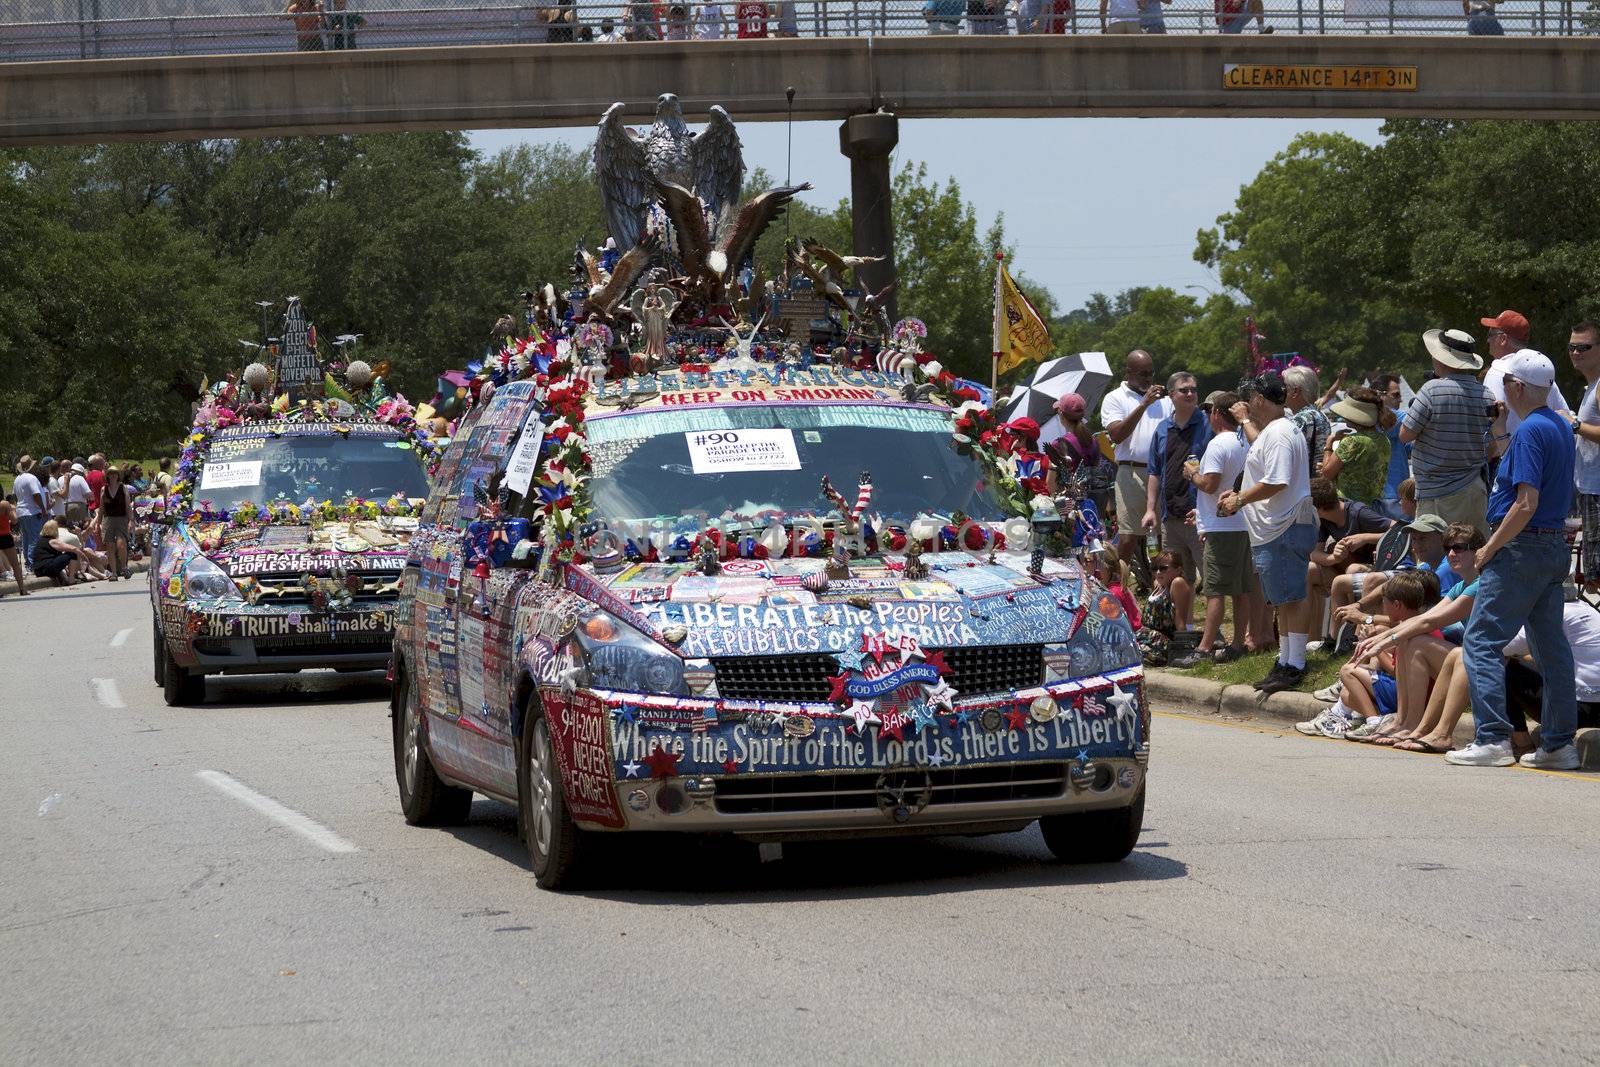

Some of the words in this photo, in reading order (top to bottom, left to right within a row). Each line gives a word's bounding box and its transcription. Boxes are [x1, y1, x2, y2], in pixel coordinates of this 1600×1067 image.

[745, 15, 761, 33] 10
[1230, 68, 1334, 86] CLEARANCE
[290, 303, 302, 319] KY
[287, 319, 307, 332] 2011
[286, 332, 308, 346] ELECT
[286, 345, 311, 355] PHIL
[281, 354, 315, 368] MOFFETT
[280, 367, 321, 382] GOVERNOR
[660, 390, 723, 406] KEEP
[731, 389, 767, 402] ON
[280, 424, 341, 434] CAPITALIS
[211, 437, 266, 448] SPEAKING
[694, 431, 740, 446] #90
[219, 450, 246, 458] LOVE
[228, 443, 264, 452] TRUTH
[707, 449, 749, 457] PARADE
[208, 463, 231, 472] #91
[228, 553, 311, 566] LIBERATE
[229, 559, 287, 576] PEOPLE'S
[289, 558, 358, 573] REPUBLICS
[659, 601, 820, 631] LIBERATE
[827, 603, 874, 626] the
[208, 613, 233, 637] the
[239, 615, 289, 637] TRUTH
[686, 627, 820, 656] REPUBLICS
[828, 626, 856, 650] of
[863, 623, 981, 648] AMERIKA
[848, 683, 871, 695] GOD
[872, 675, 900, 693] BLESS
[899, 664, 938, 680] AMERICA
[639, 710, 667, 719] RAND
[652, 720, 679, 728] SENATE
[610, 716, 685, 763] Where
[690, 725, 729, 763] the
[732, 723, 800, 774] Spirit
[804, 728, 829, 767] of
[828, 724, 866, 766] the
[869, 724, 928, 767] Lord
[961, 719, 1020, 760] there
[1026, 721, 1048, 751] is
[1053, 708, 1137, 756] Liberty
[573, 739, 609, 777] NEVER
[571, 769, 612, 806] FORGET
